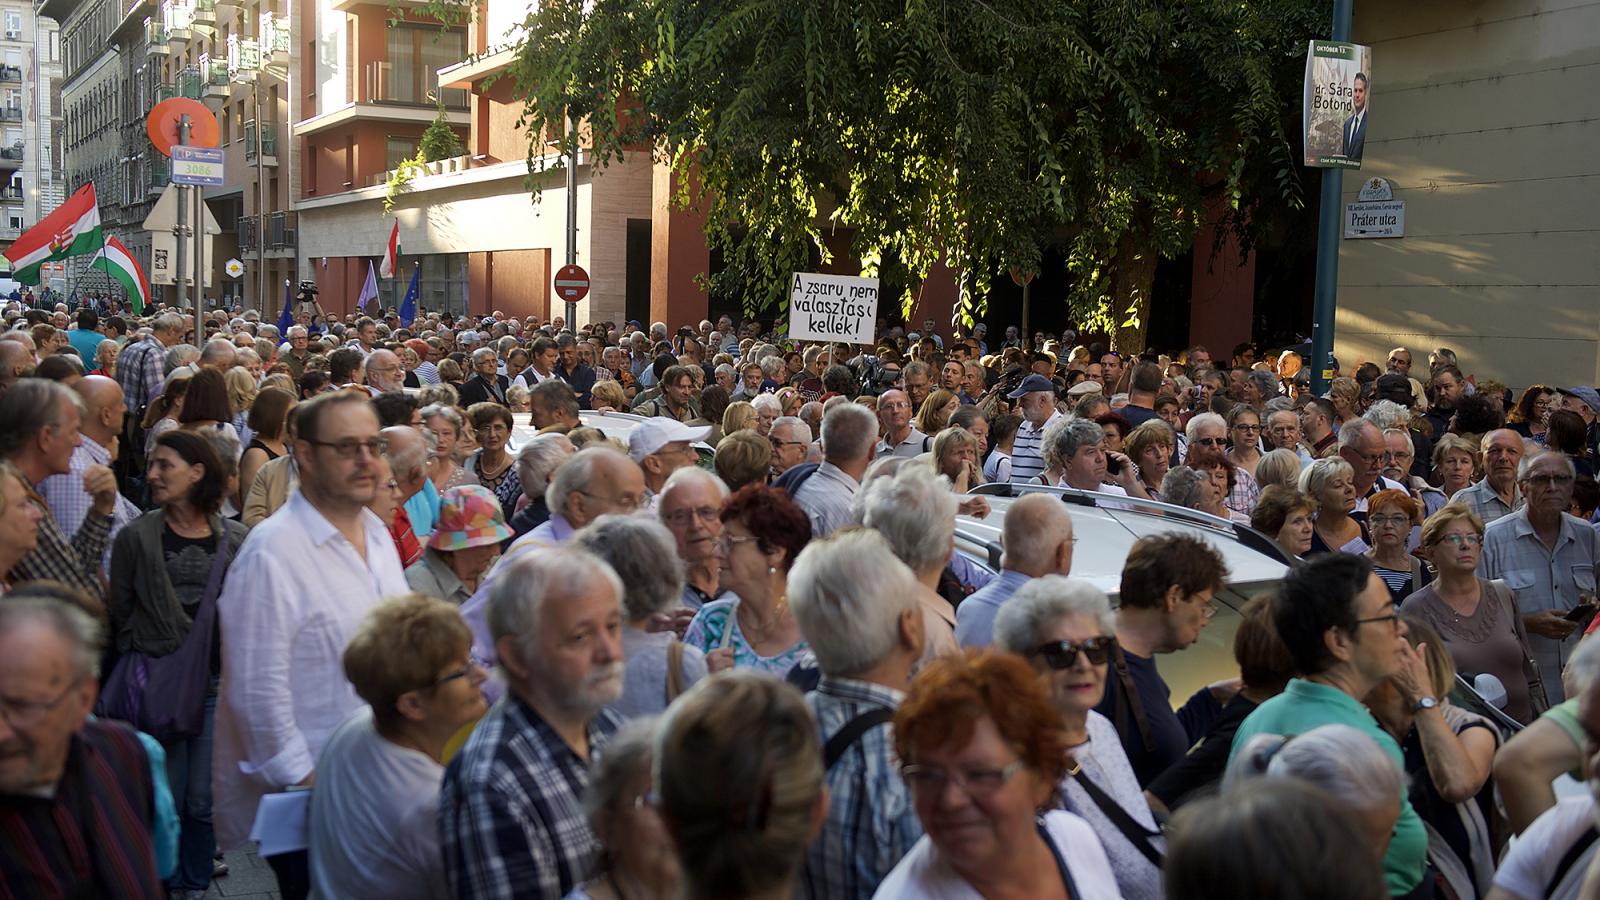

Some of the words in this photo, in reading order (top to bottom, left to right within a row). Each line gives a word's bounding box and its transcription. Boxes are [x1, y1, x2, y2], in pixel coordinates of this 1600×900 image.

[1315, 84, 1327, 95] dr.
[1329, 82, 1353, 97] Sára
[1314, 96, 1353, 111] Botond
[185, 164, 211, 175] 3086
[1351, 212, 1377, 226] Práter
[1380, 213, 1397, 225] utca
[792, 273, 803, 293] A
[806, 281, 844, 296] zsaru
[849, 285, 878, 300] nem
[794, 294, 873, 318] választási
[808, 313, 860, 340] kellék!
